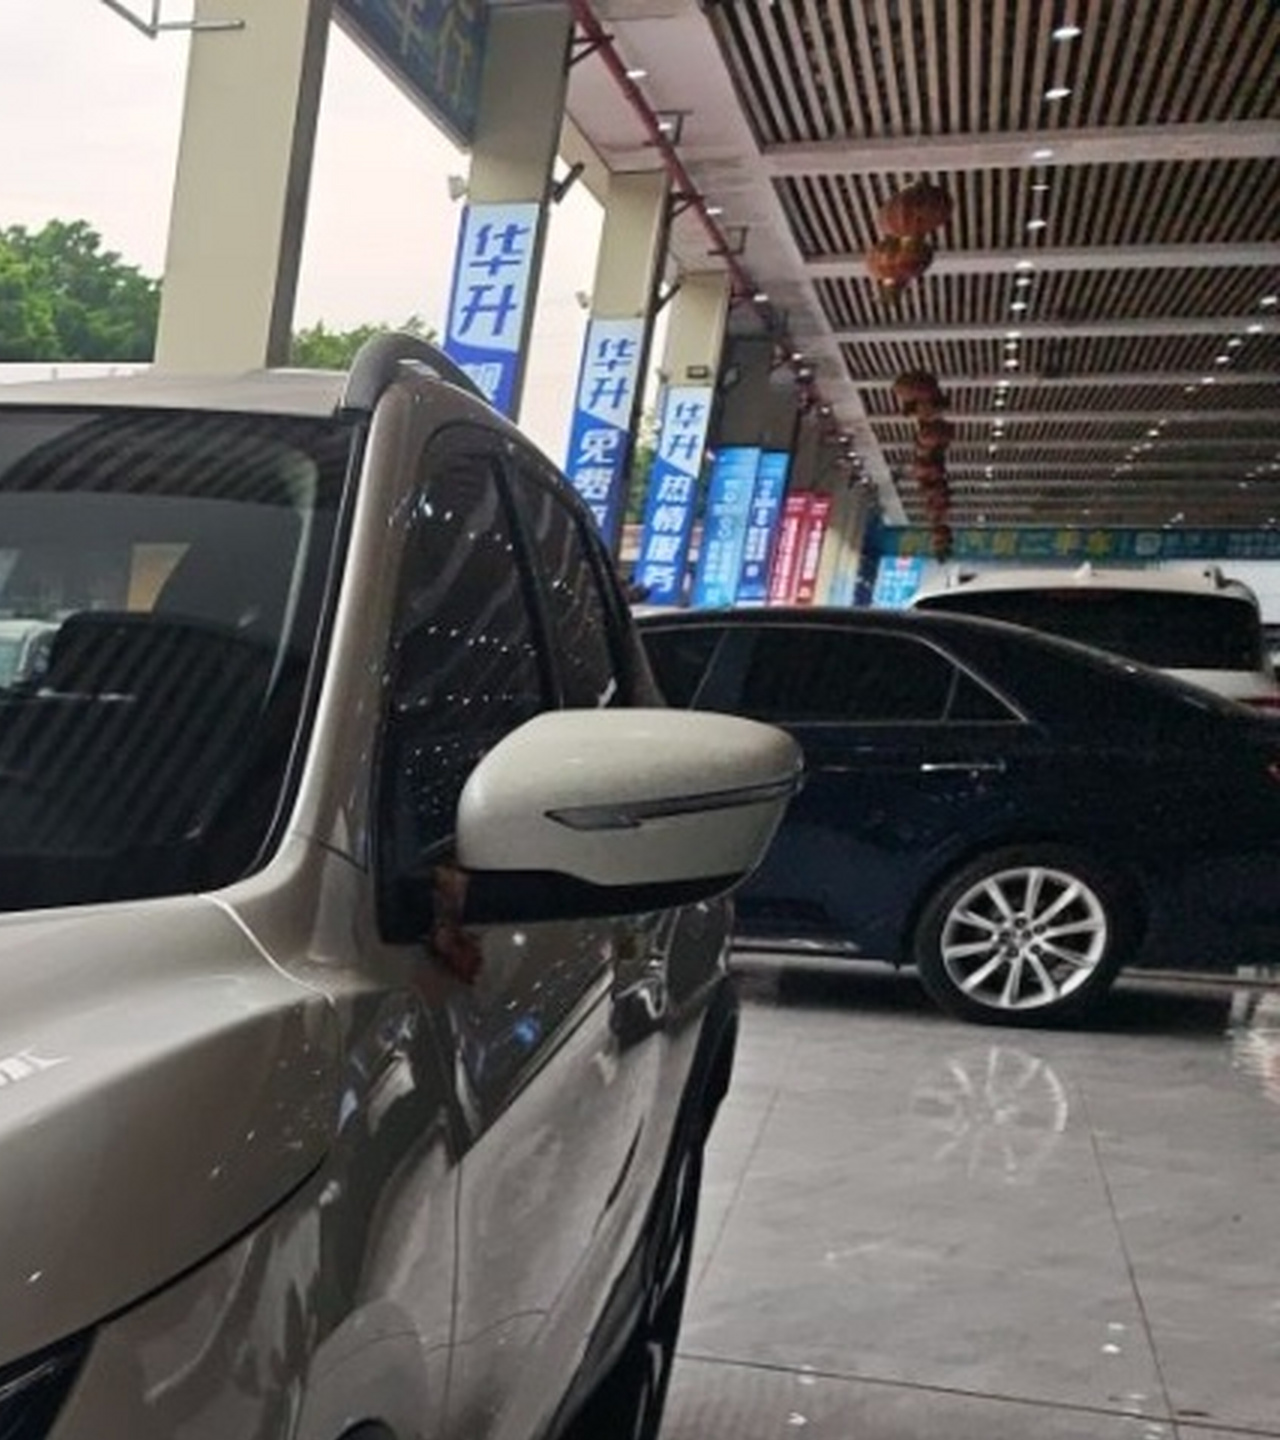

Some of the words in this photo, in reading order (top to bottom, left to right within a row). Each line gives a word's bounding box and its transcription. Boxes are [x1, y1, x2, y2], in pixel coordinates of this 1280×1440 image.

[457, 223, 531, 337] 华升
[589, 337, 637, 410] 华升
[667, 402, 705, 461] 华升
